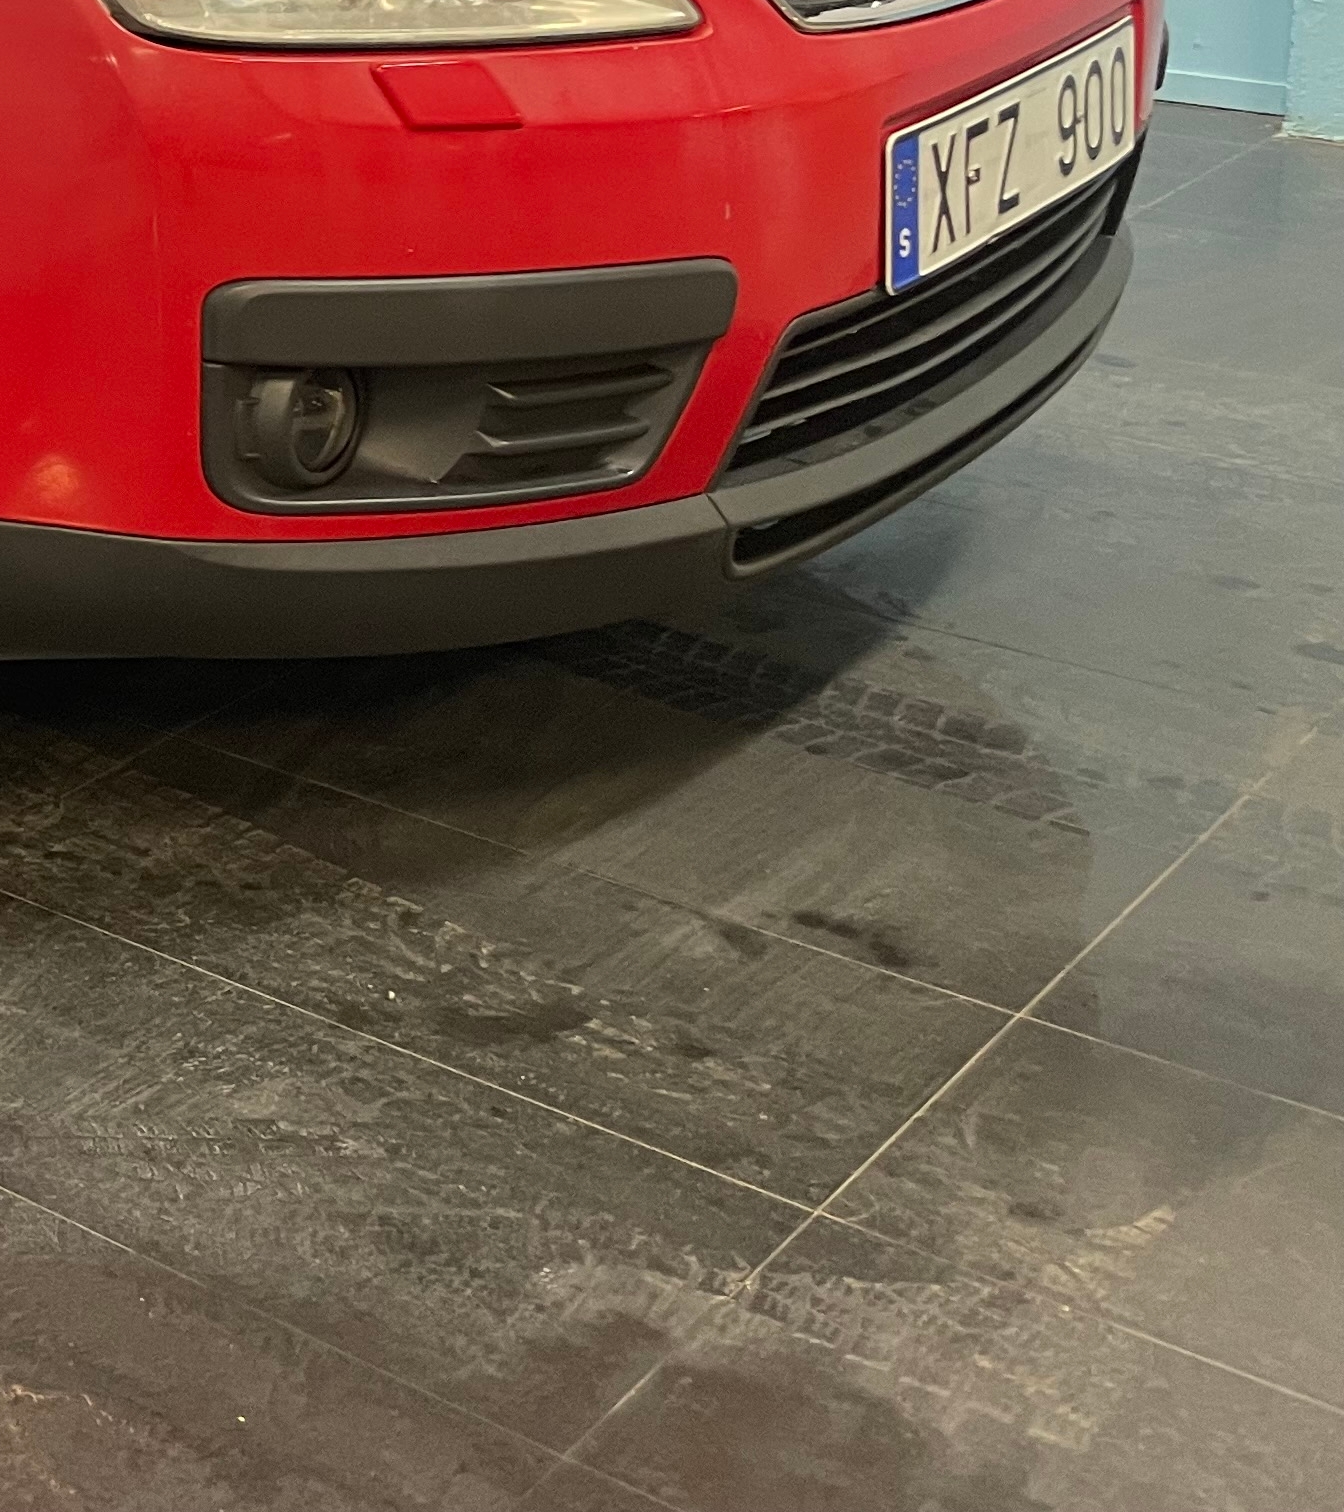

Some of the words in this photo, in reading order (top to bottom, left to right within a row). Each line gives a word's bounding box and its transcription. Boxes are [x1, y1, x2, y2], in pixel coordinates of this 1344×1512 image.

[931, 99, 1020, 256] XFZ
[1058, 46, 1126, 176] 900
[898, 227, 912, 258] S
